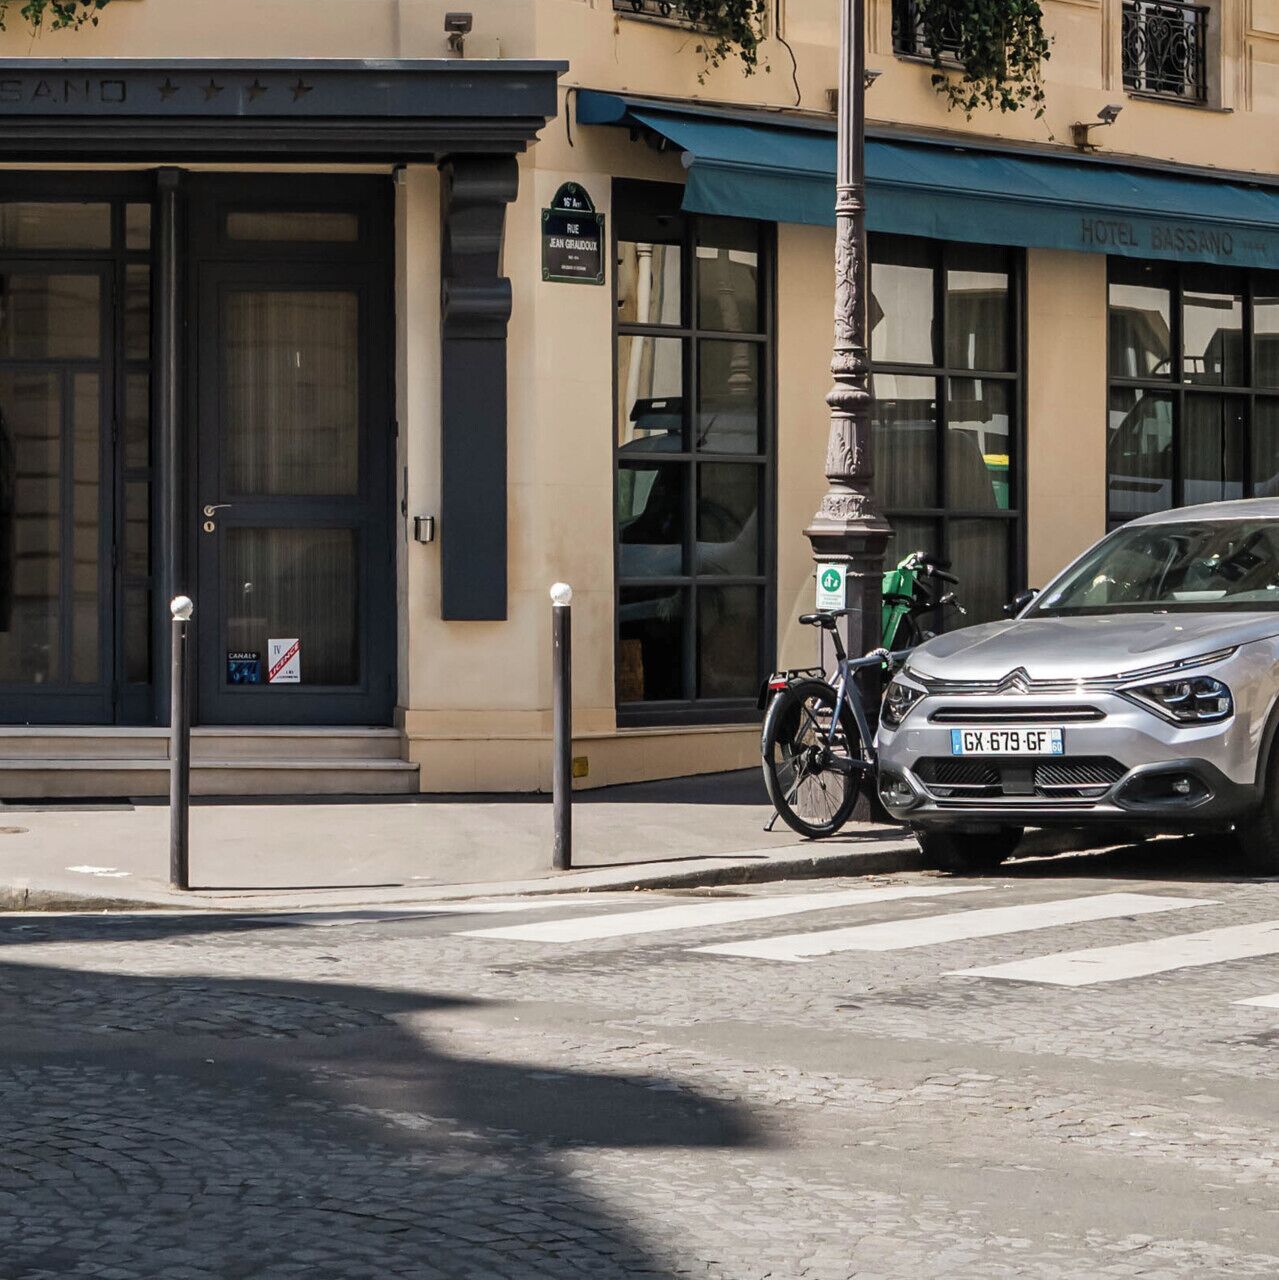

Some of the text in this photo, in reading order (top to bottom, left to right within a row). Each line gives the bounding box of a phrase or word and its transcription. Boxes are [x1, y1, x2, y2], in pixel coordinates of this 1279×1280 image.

[566, 223, 580, 235] RUE
[549, 237, 598, 252] JEAN GIRAUDOUX
[1081, 218, 1233, 257] HOTEL BASSANO
[228, 652, 257, 660] CANAL+
[269, 641, 300, 679] LICENCE
